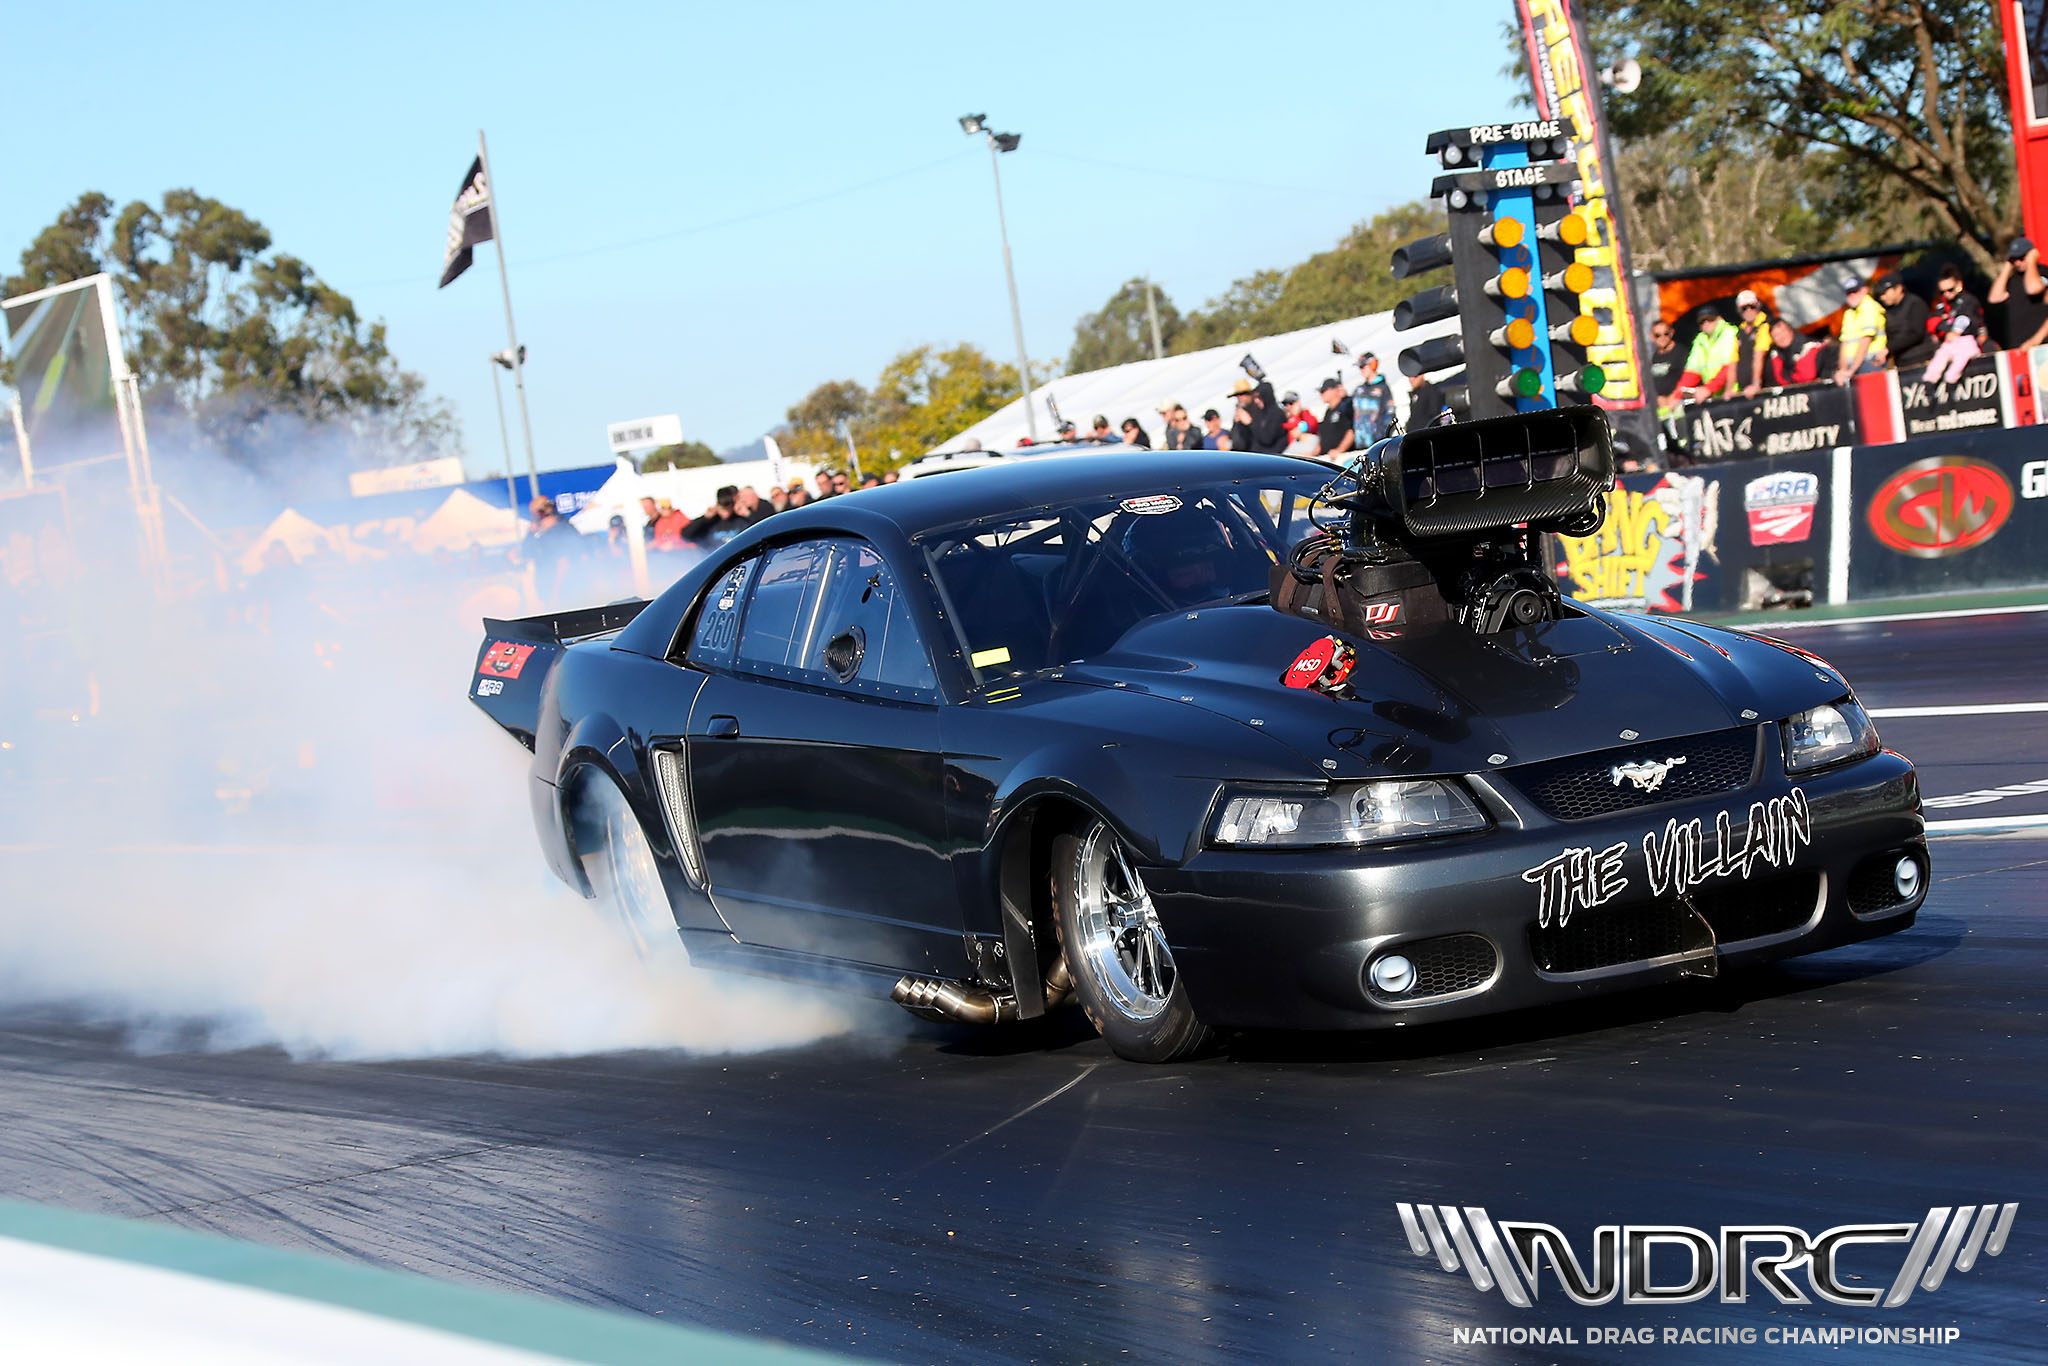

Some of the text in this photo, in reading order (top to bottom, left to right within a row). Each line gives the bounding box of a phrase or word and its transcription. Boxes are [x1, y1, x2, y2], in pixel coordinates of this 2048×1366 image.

[1469, 120, 1562, 144] PRE-STAGE
[1495, 167, 1546, 188] STAGE
[1762, 393, 1810, 419] HAIR
[1766, 424, 1840, 456] BEAUTY
[1571, 555, 1657, 602] SHIFT
[700, 609, 736, 651] 260
[1293, 658, 1322, 672] MSD
[1522, 787, 1812, 929] THE VILLAIN
